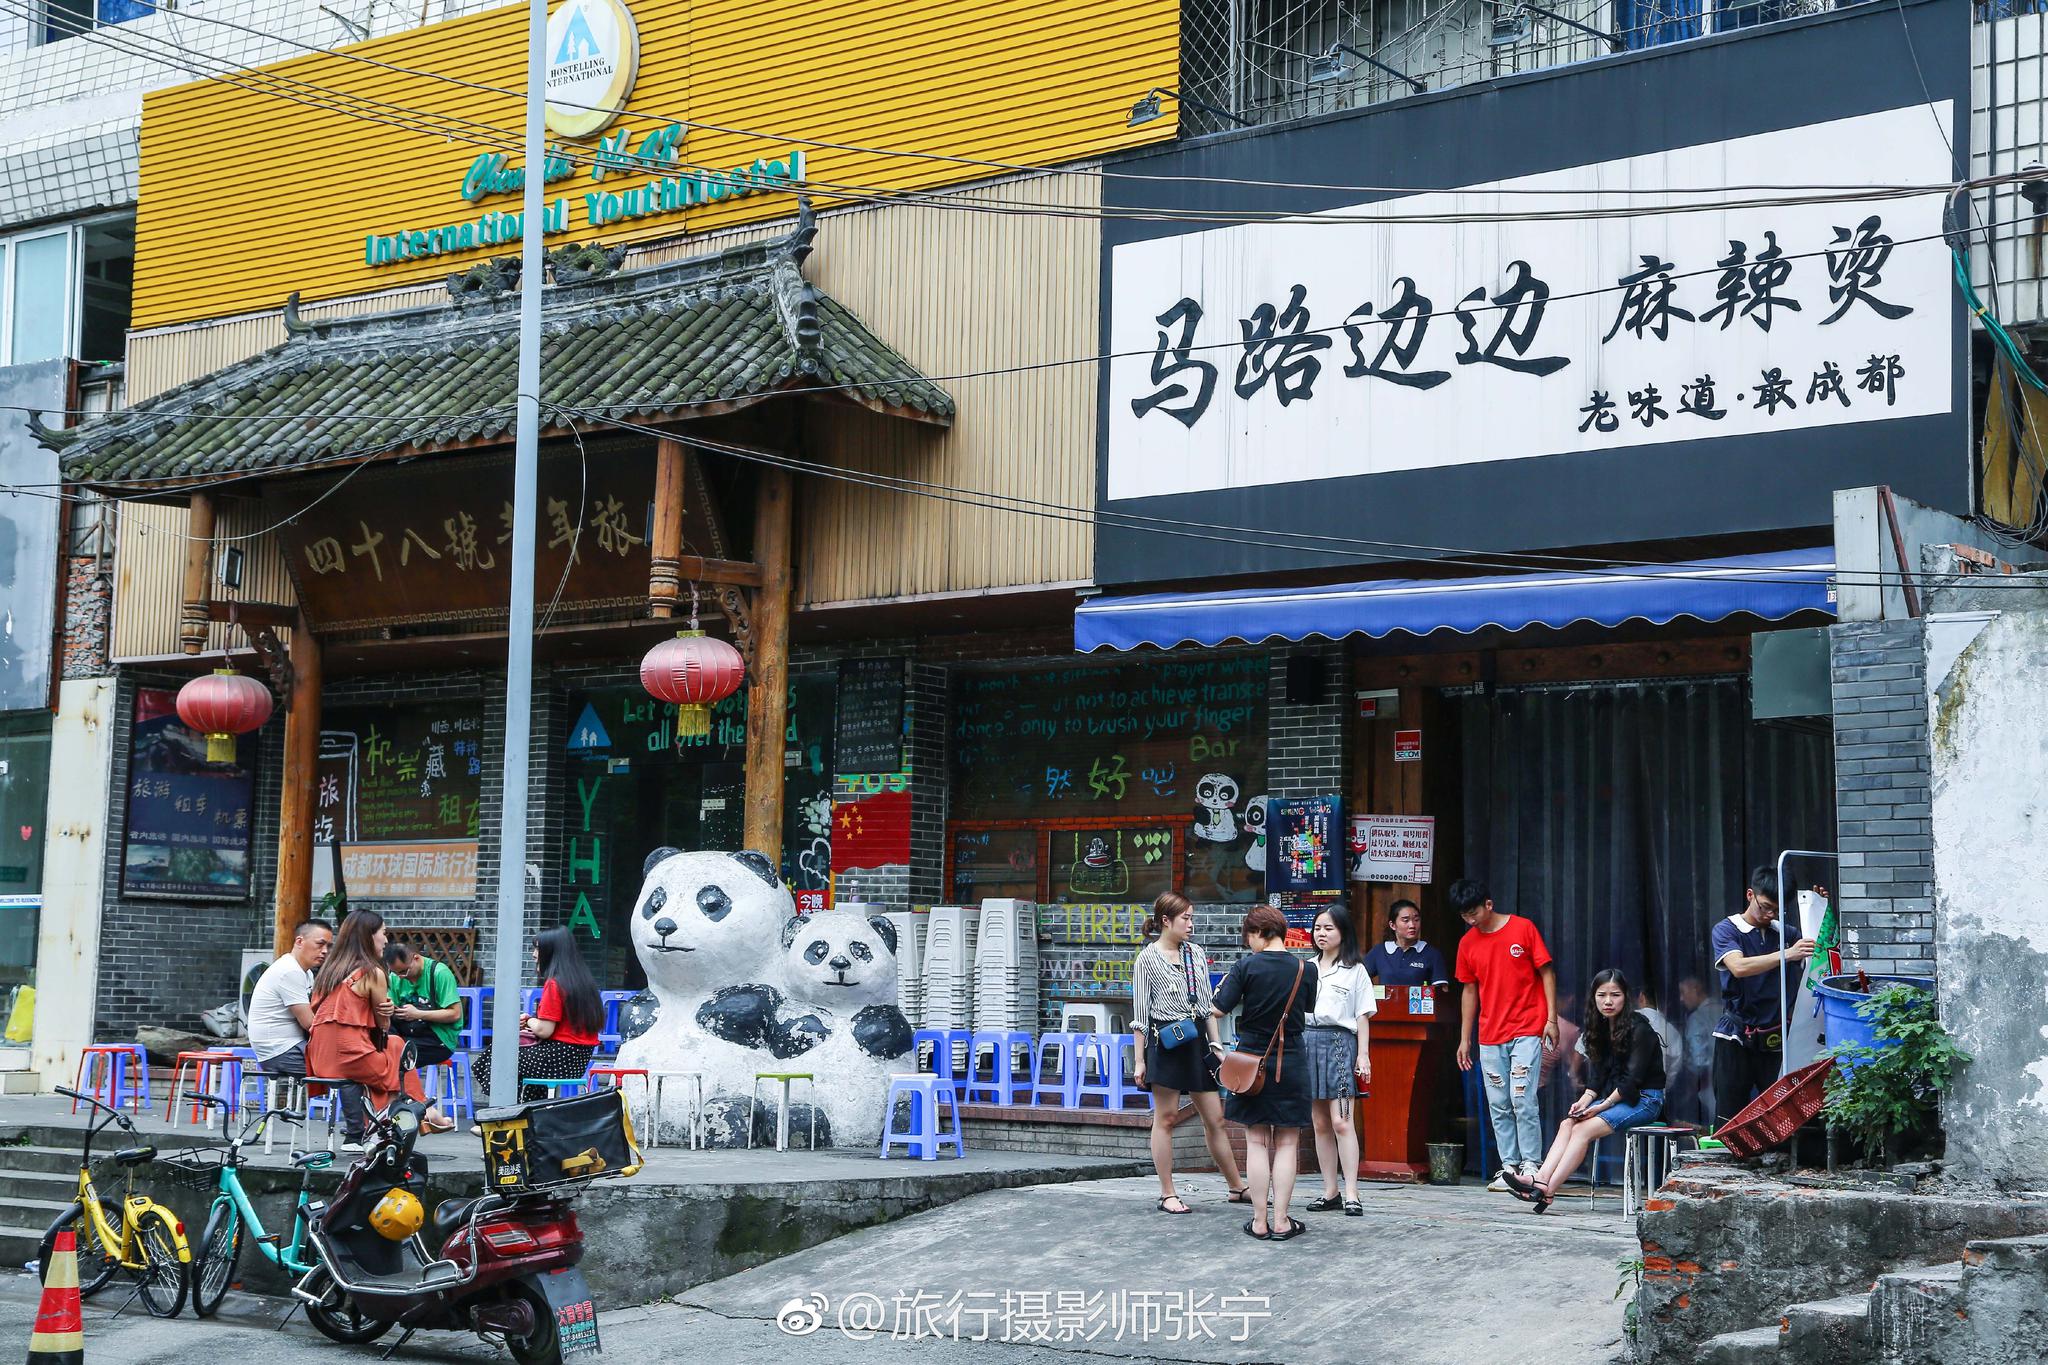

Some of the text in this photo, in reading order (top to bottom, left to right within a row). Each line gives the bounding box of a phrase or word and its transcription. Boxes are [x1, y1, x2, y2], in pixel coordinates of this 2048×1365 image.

[546, 66, 614, 89] NTERNATIONAL
[550, 57, 606, 79] HOSTELLING
[1131, 214, 1915, 430] 马路边边 麻辣烫
[623, 699, 655, 724] Let
[648, 719, 670, 751] all
[718, 716, 745, 745] the
[1188, 735, 1241, 762] Bar
[1396, 751, 1420, 759] SECOM
[213, 807, 249, 830] 机票
[344, 851, 478, 881] 成都环球国际旅行社
[567, 776, 602, 939] YHA
[800, 894, 823, 909] 今晚
[1062, 904, 1147, 943] TIRED
